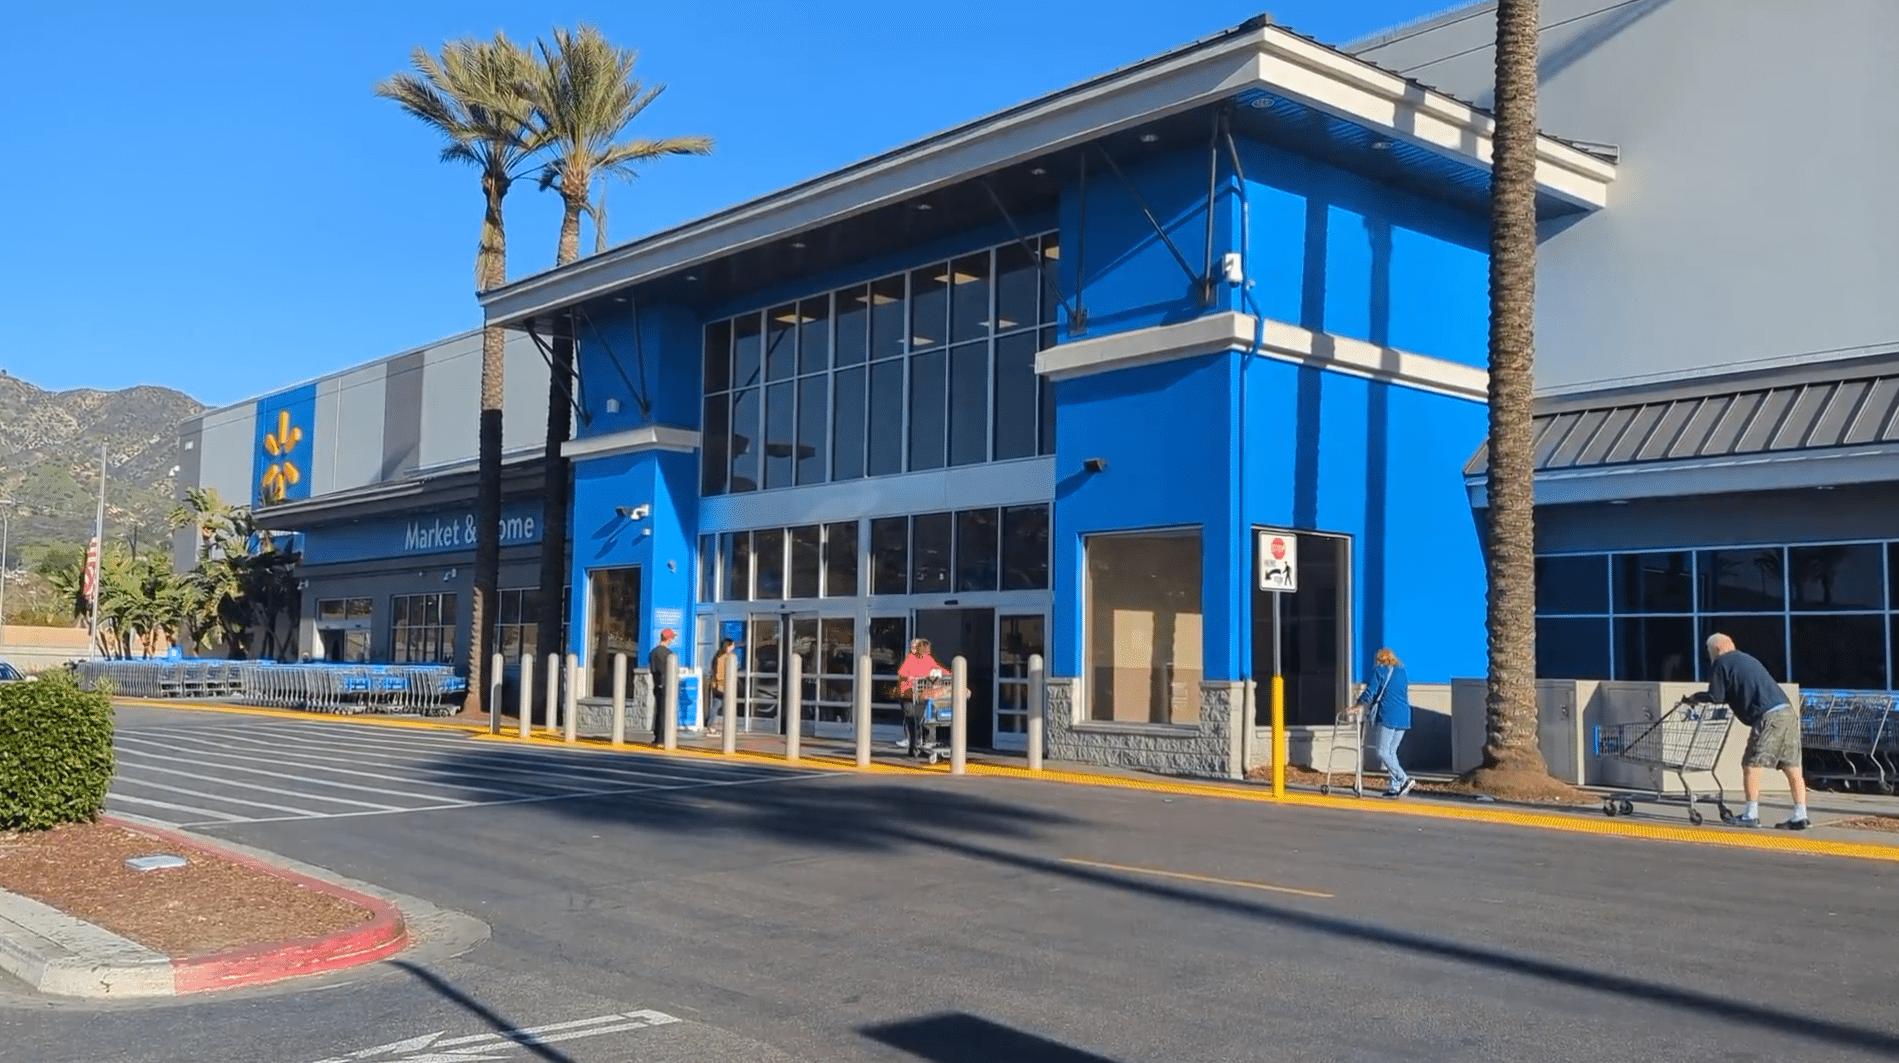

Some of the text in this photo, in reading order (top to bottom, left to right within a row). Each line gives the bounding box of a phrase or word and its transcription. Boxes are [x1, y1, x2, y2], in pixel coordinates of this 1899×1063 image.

[404, 514, 535, 550] Market & ome
